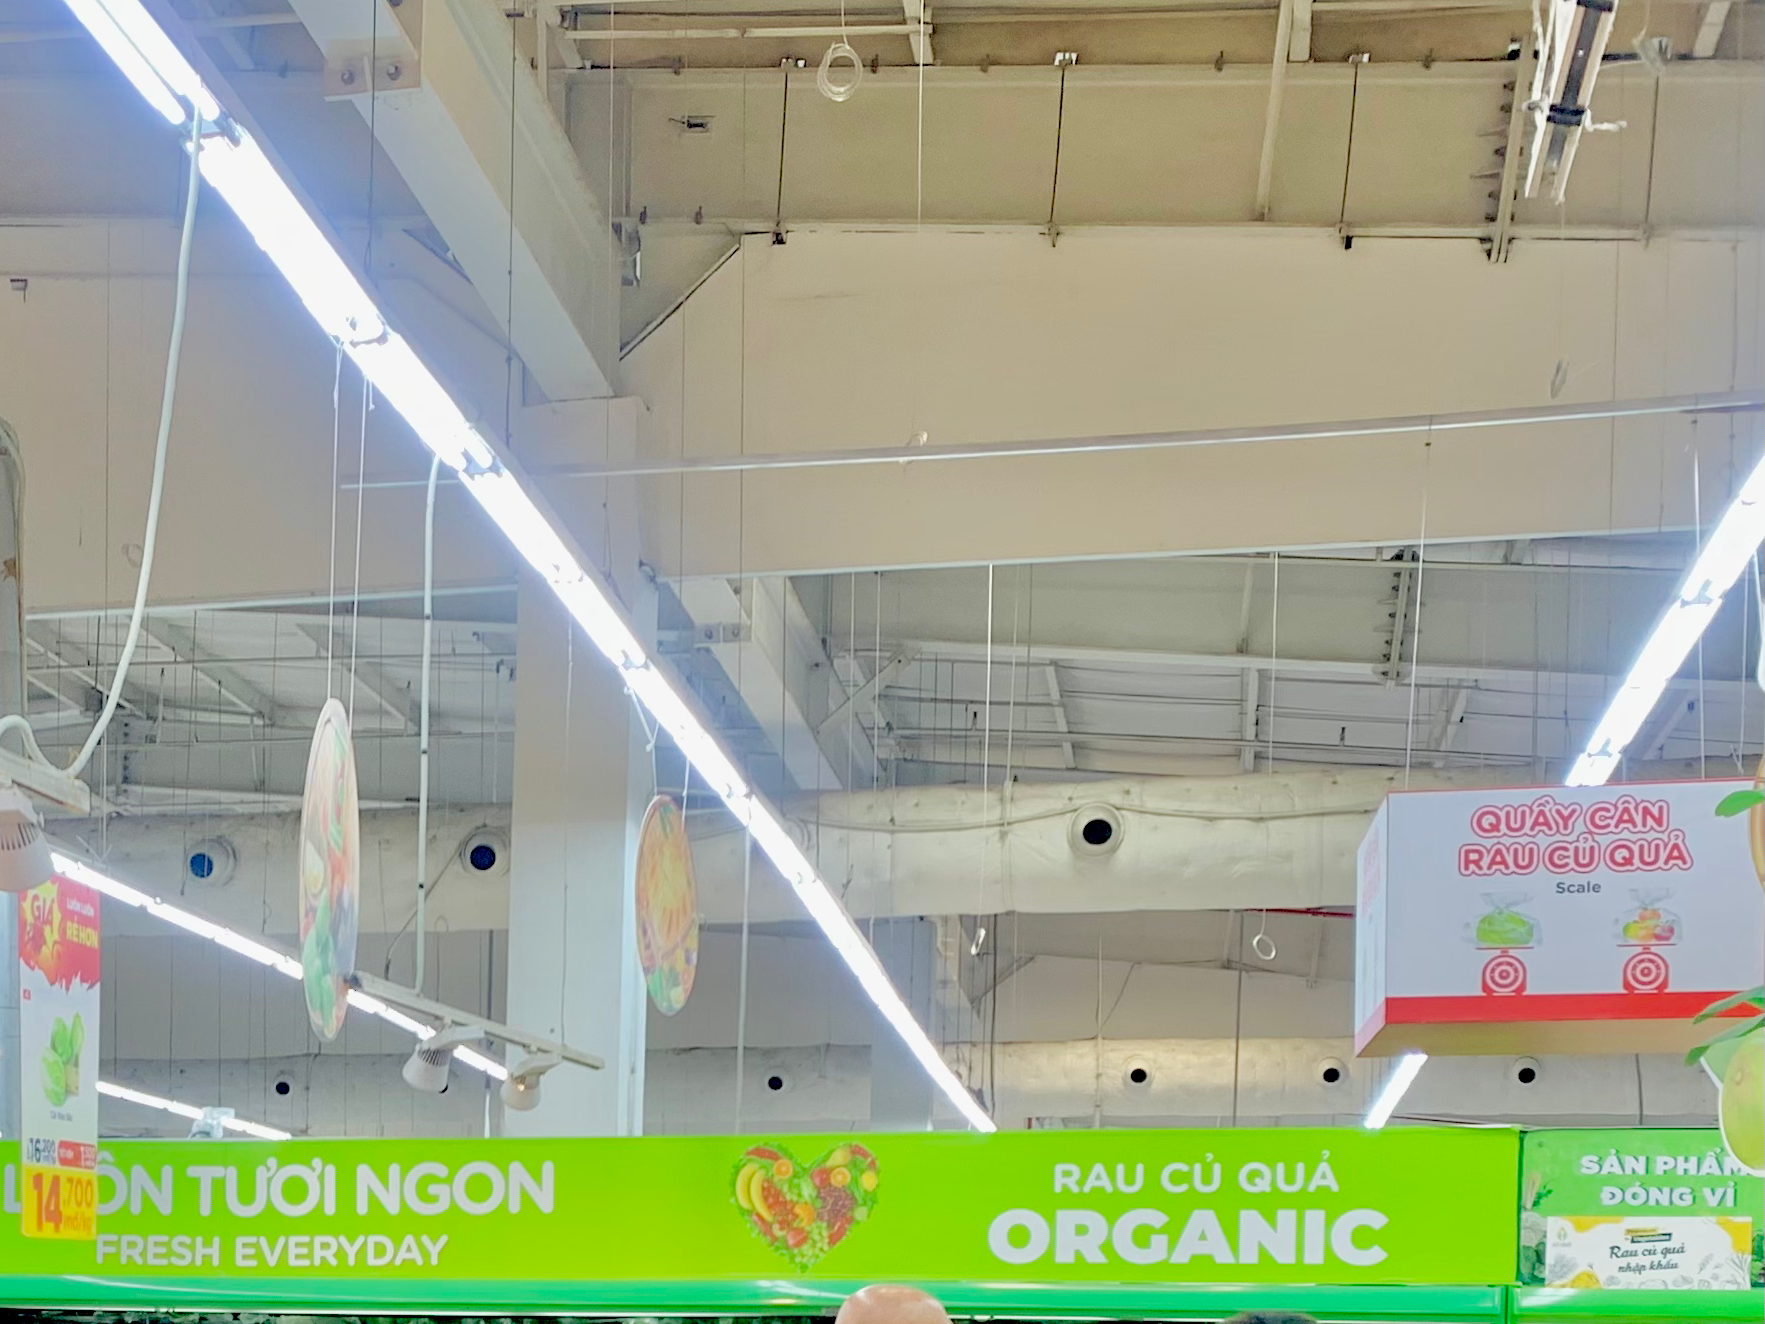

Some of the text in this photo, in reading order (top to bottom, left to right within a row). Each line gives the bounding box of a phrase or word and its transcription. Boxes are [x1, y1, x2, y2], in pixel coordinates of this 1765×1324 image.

[1472, 795, 1669, 837] QUẦY CÂN
[1459, 830, 1693, 876] RAU CỦ QUẢ
[1555, 881, 1601, 895] Scale
[1054, 1150, 1339, 1195] RAU CỦ QUẢ
[1580, 1148, 1647, 1176] SẢN
[3, 1157, 555, 1218] LÔN TƯƠI NGON
[32, 1172, 93, 1233] 14.700
[1600, 1181, 1737, 1207] ĐÓNG VỈ
[96, 1234, 449, 1267] FRESH EVERYDAY
[987, 1208, 1390, 1267] ORGANIC
[1609, 1245, 1639, 1260] Rau
[1642, 1244, 1657, 1257] củ
[1618, 1261, 1647, 1276] nhập
